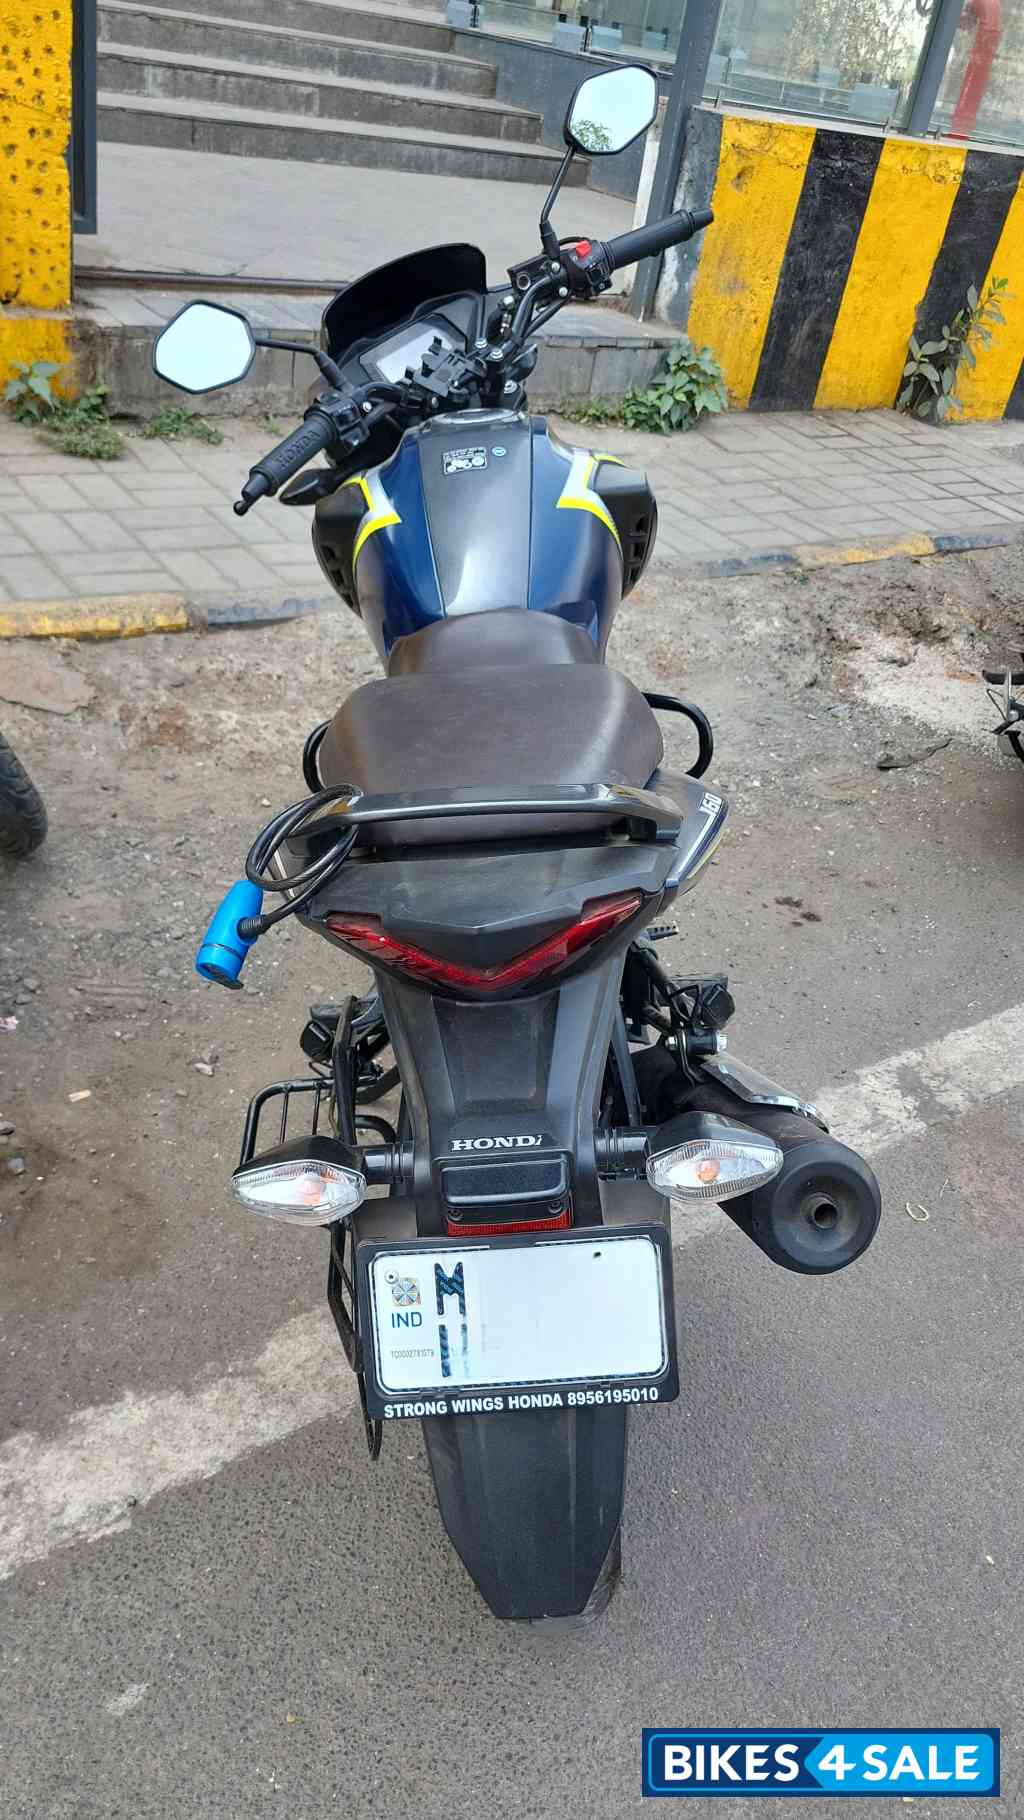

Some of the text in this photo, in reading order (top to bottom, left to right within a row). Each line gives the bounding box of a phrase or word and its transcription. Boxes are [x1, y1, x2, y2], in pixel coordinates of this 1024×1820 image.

[699, 792, 722, 816] 160
[391, 1311, 423, 1328] IND
[383, 1387, 659, 1419] STRONG WINGS HONDA 8956195010
